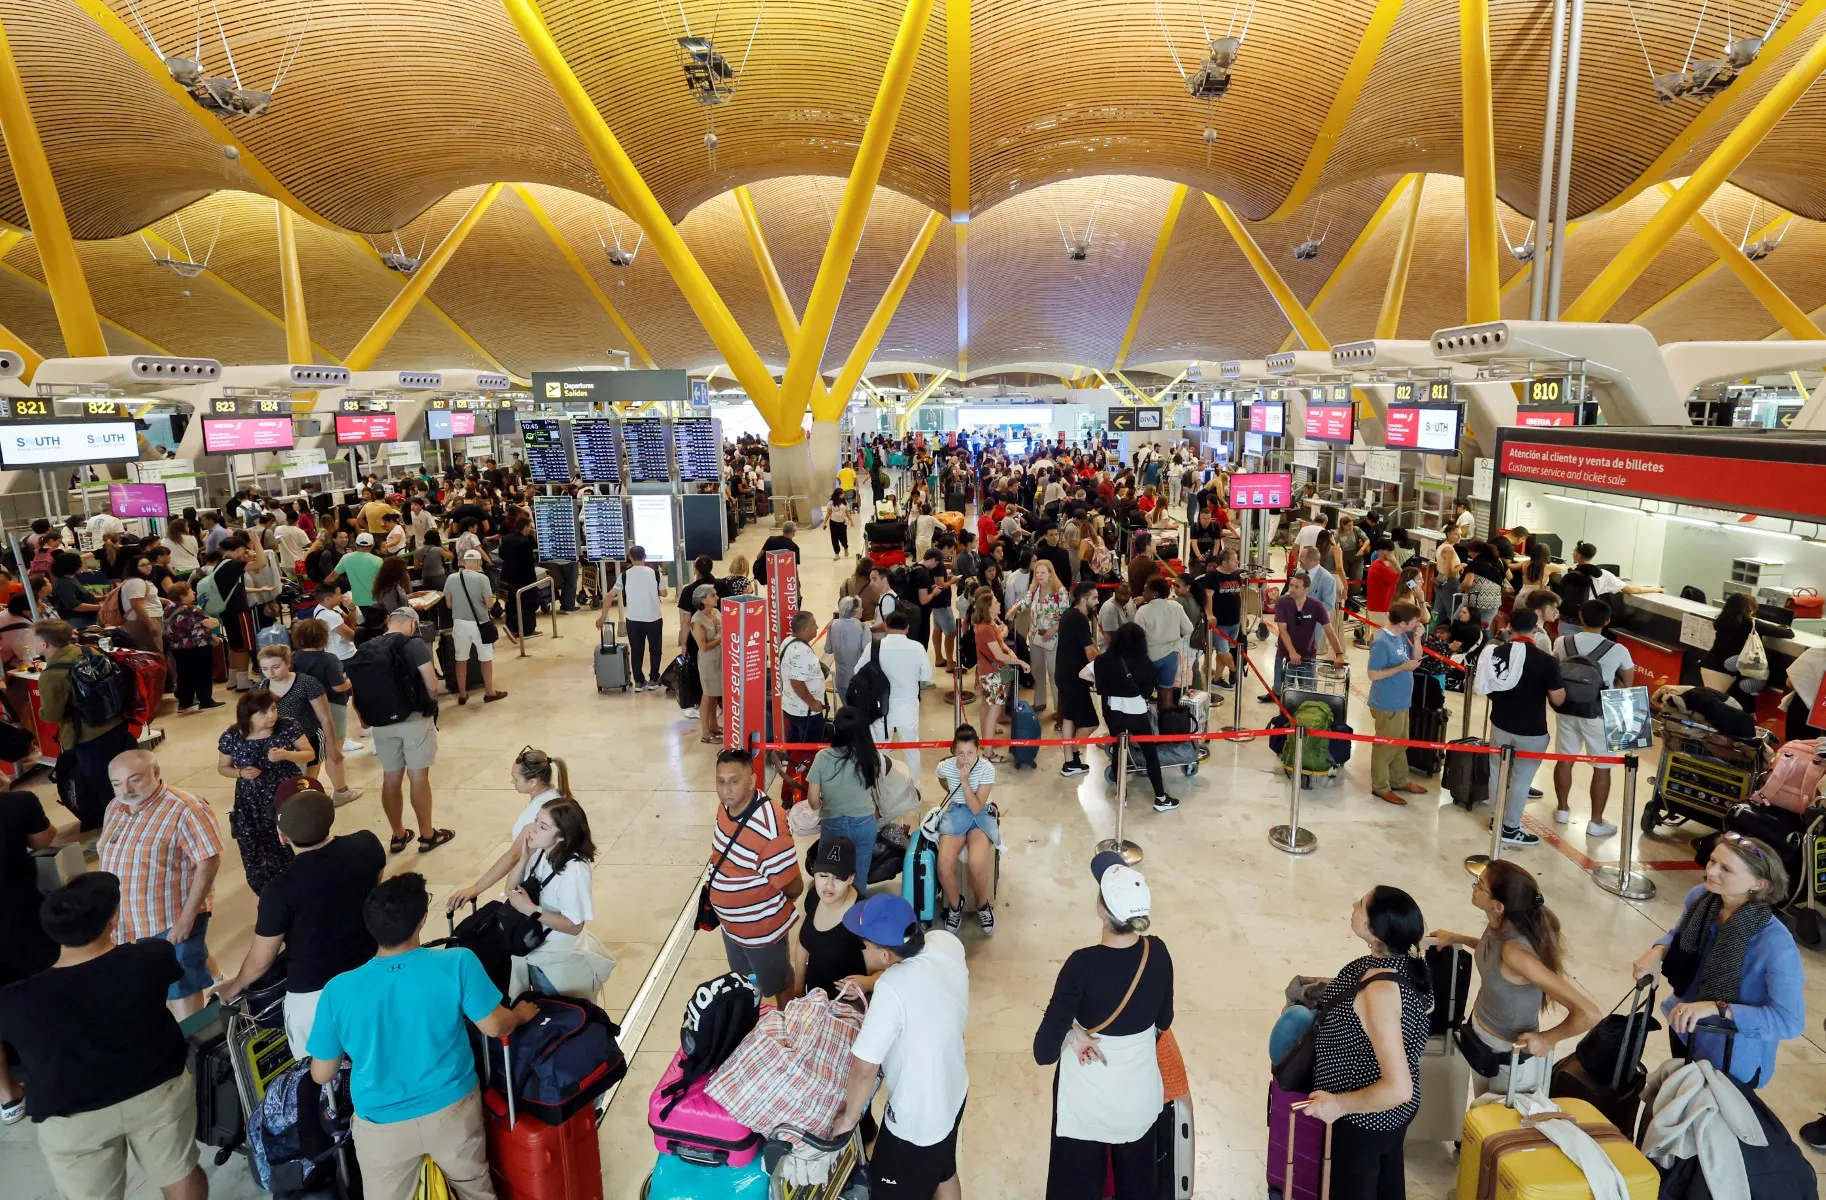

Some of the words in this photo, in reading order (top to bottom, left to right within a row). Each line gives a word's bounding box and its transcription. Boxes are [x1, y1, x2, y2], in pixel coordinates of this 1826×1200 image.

[1396, 386, 1411, 399] 812
[1431, 384, 1448, 399] 811
[1532, 382, 1559, 400] 810
[16, 401, 47, 414] 821
[88, 402, 116, 414] 822
[215, 401, 236, 412] 823
[260, 401, 278, 411] 824
[344, 401, 358, 410] 825
[16, 436, 61, 447] SOUTH
[87, 434, 125, 443] SOUTH
[1509, 448, 1540, 460] Atención
[1542, 451, 1548, 461] al
[1550, 452, 1577, 464] cliente
[1578, 457, 1584, 467] y
[1585, 457, 1611, 469] venta
[1612, 458, 1624, 469] de
[1625, 459, 1664, 473] billetes
[1508, 462, 1540, 474] Customer
[1540, 467, 1565, 478] service
[1566, 470, 1582, 480] and
[1583, 472, 1606, 484] ticket
[1607, 474, 1626, 486] sale
[784, 576, 796, 611] sales
[770, 577, 778, 632] billetes
[772, 635, 779, 654] de
[728, 632, 740, 696] service
[774, 656, 782, 697] Venta
[730, 696, 740, 750] tomer
[827, 845, 840, 861] A
